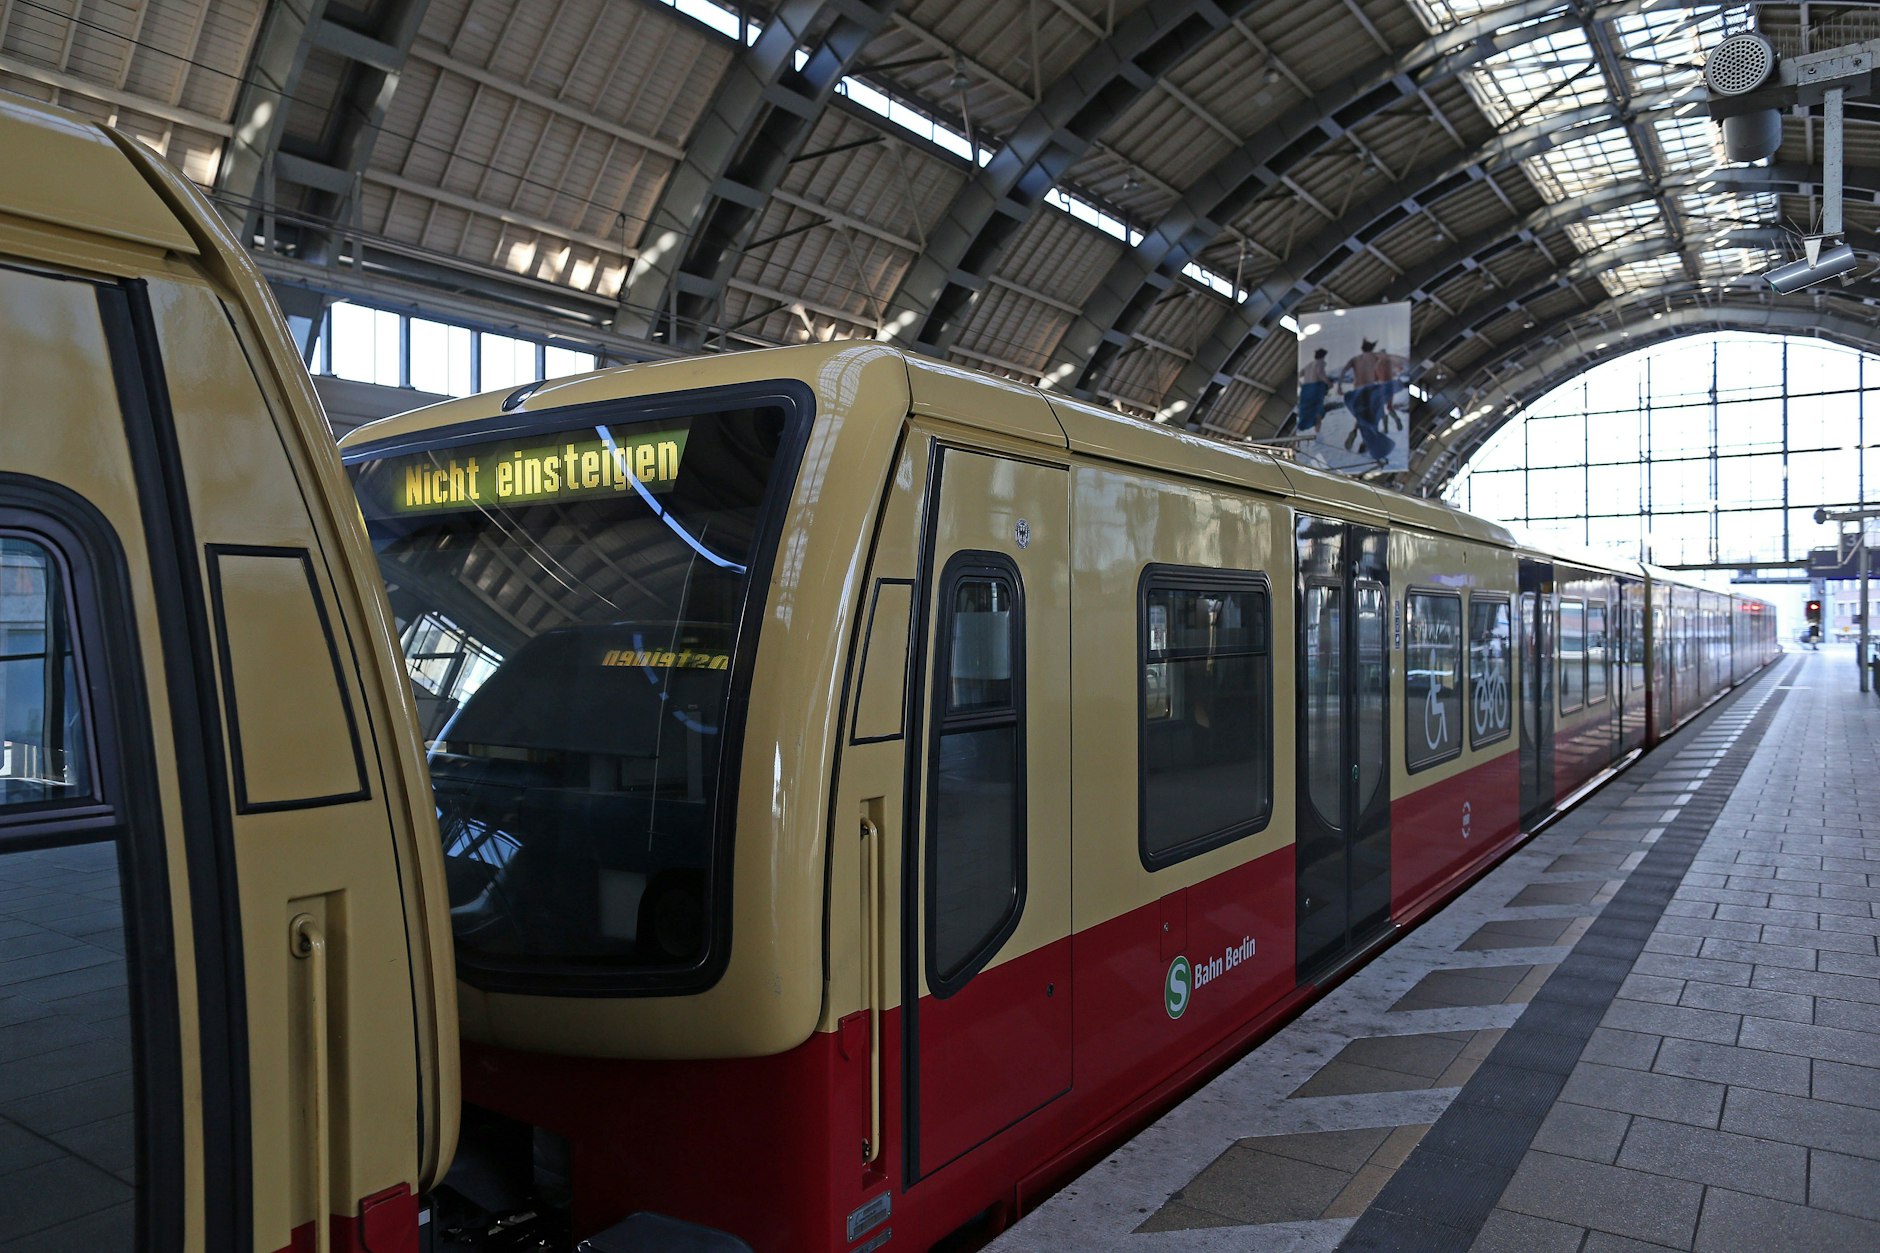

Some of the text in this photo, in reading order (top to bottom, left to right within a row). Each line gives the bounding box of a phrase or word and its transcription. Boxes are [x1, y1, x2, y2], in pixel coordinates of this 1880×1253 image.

[405, 439, 678, 506] Nicht einsteigen
[1170, 935, 1256, 1012] S Bahn Berlin
